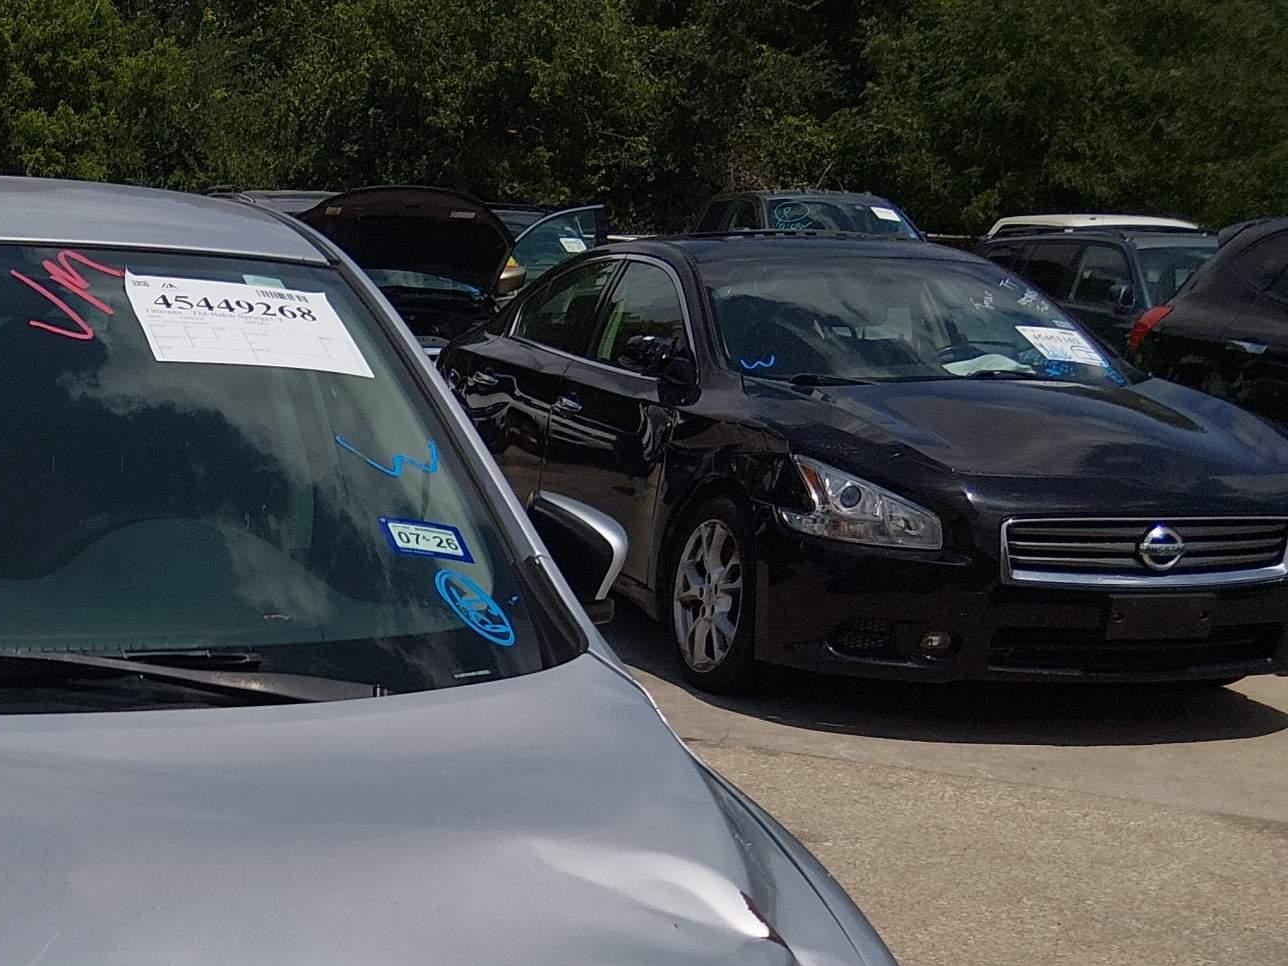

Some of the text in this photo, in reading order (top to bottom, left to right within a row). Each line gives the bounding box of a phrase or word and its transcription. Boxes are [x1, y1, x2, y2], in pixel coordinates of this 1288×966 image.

[154, 293, 317, 322] 45449268
[398, 531, 420, 545] 07
[432, 536, 459, 551] 26
